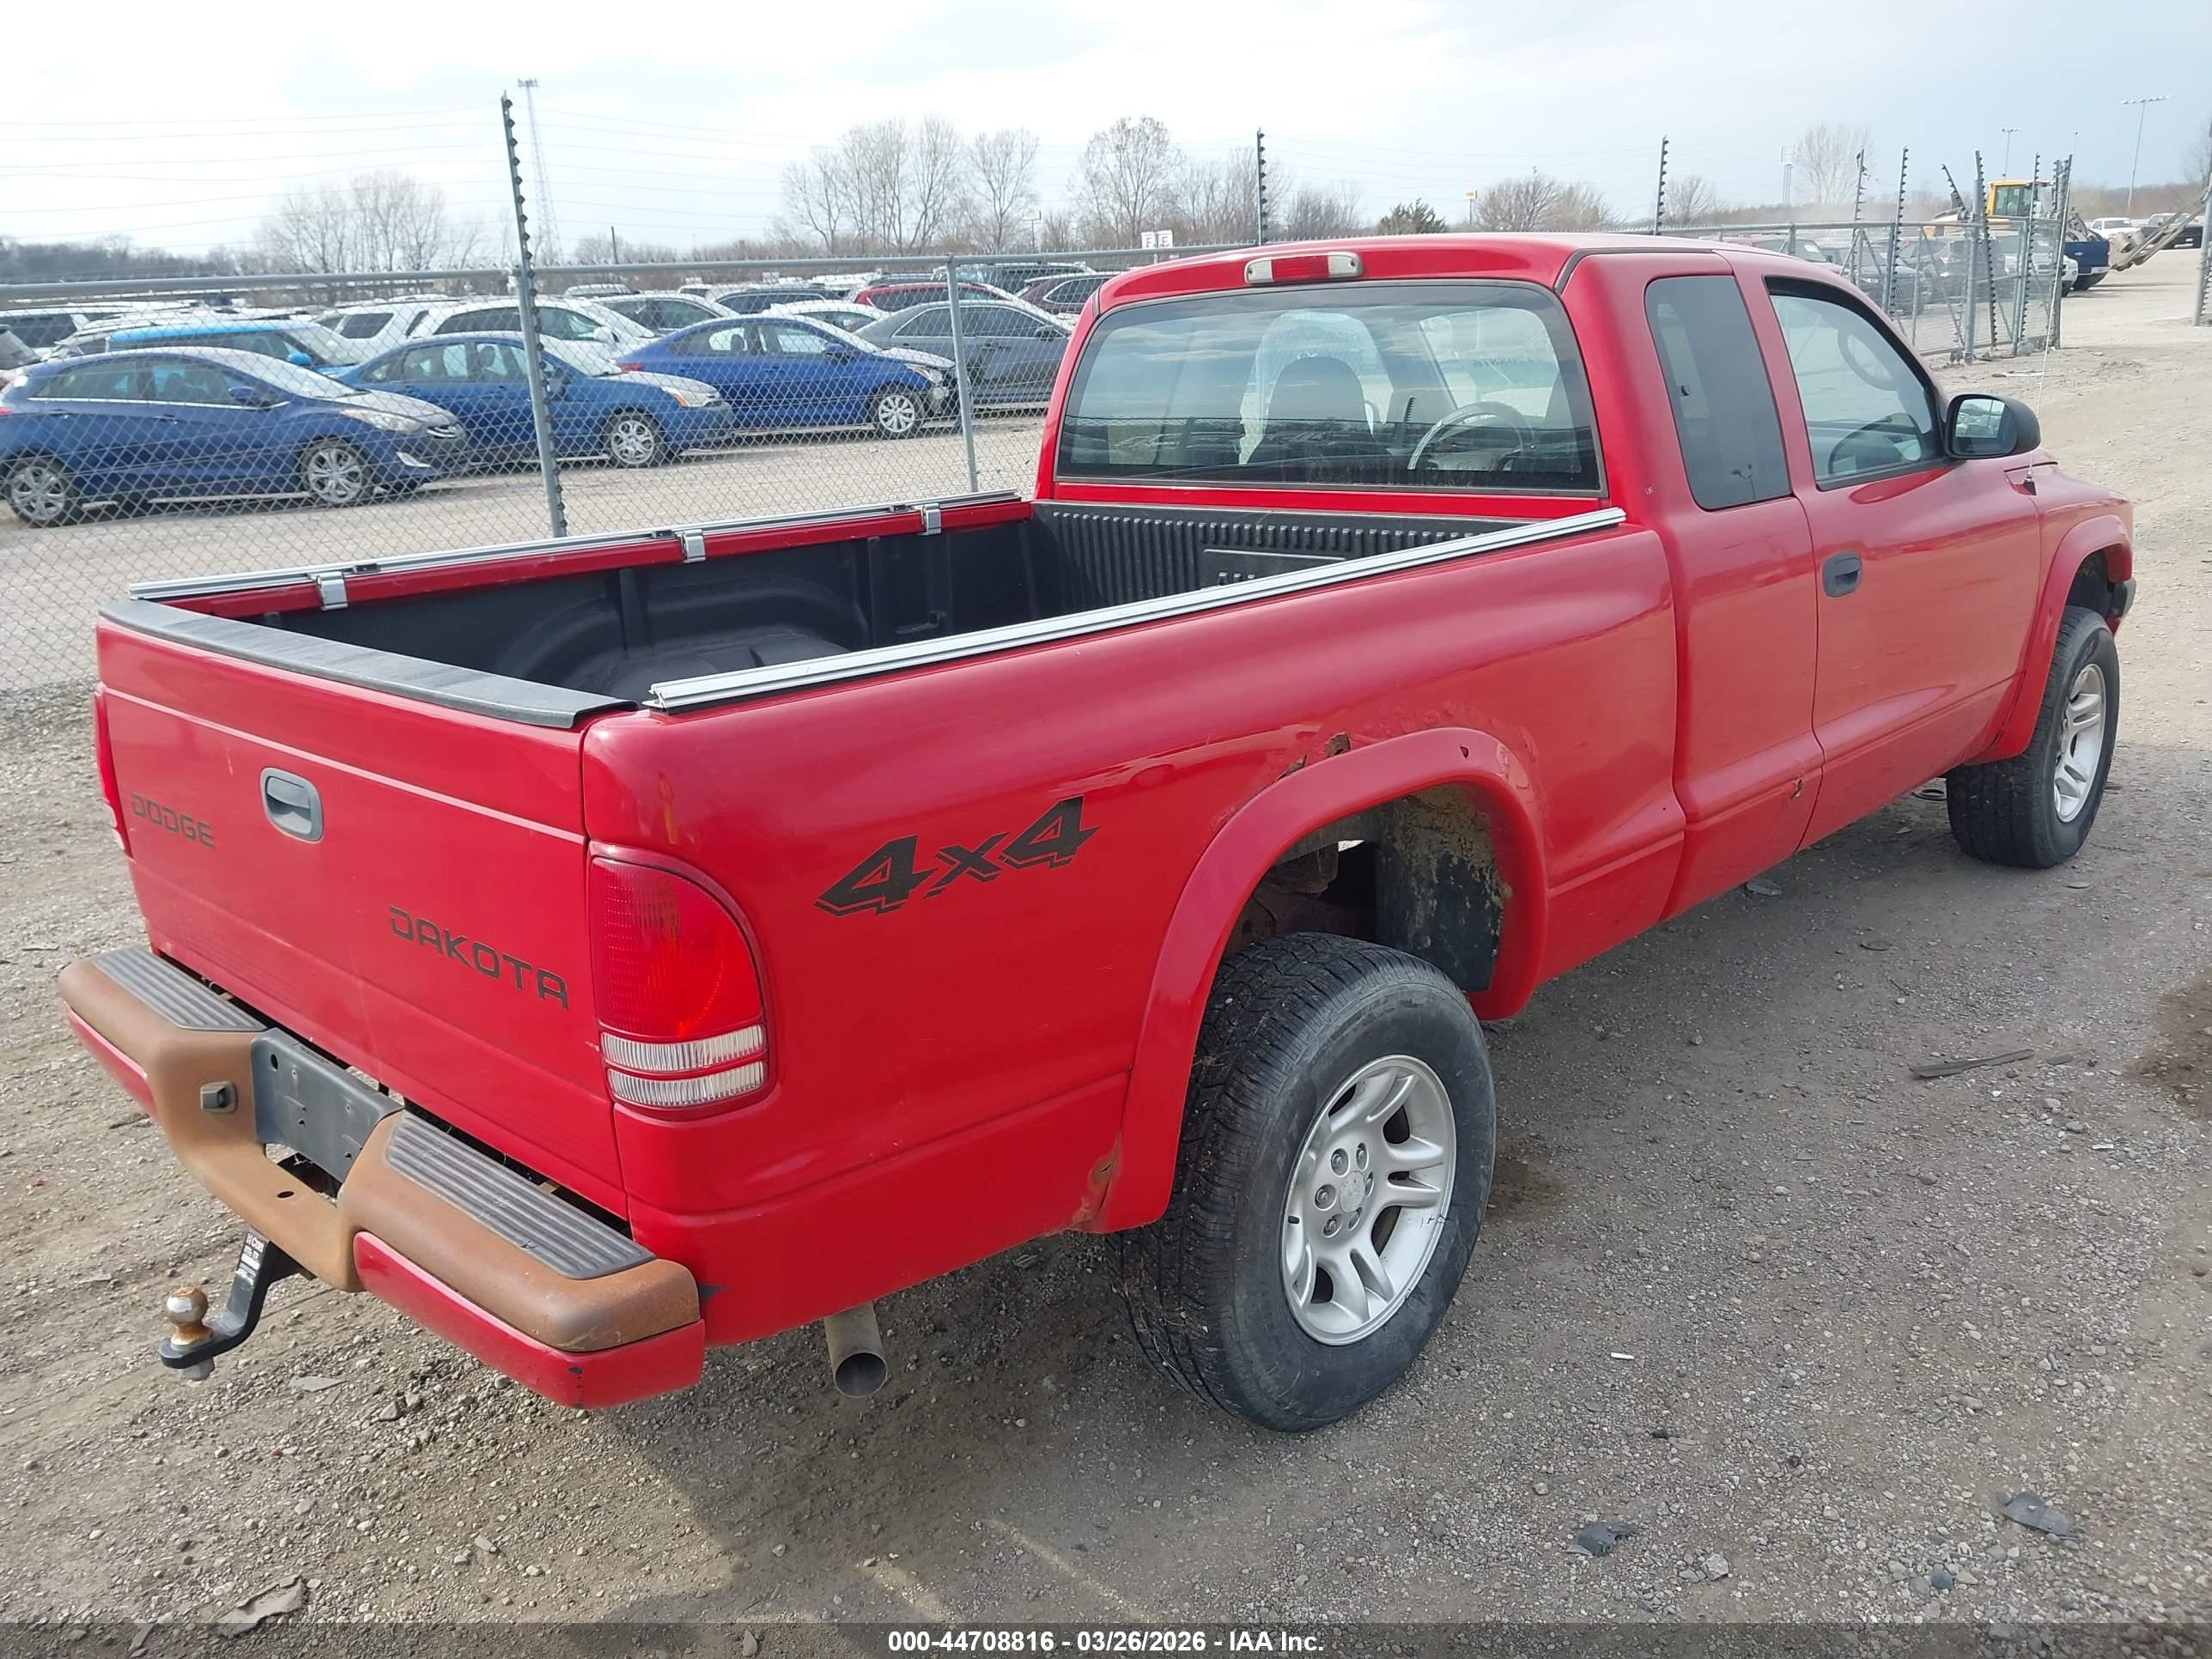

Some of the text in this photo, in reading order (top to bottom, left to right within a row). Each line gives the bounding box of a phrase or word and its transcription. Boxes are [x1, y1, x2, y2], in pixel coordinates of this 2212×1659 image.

[131, 794, 215, 848] DODGE
[814, 794, 1102, 917] 4x4
[388, 907, 568, 1010] DAKOTA
